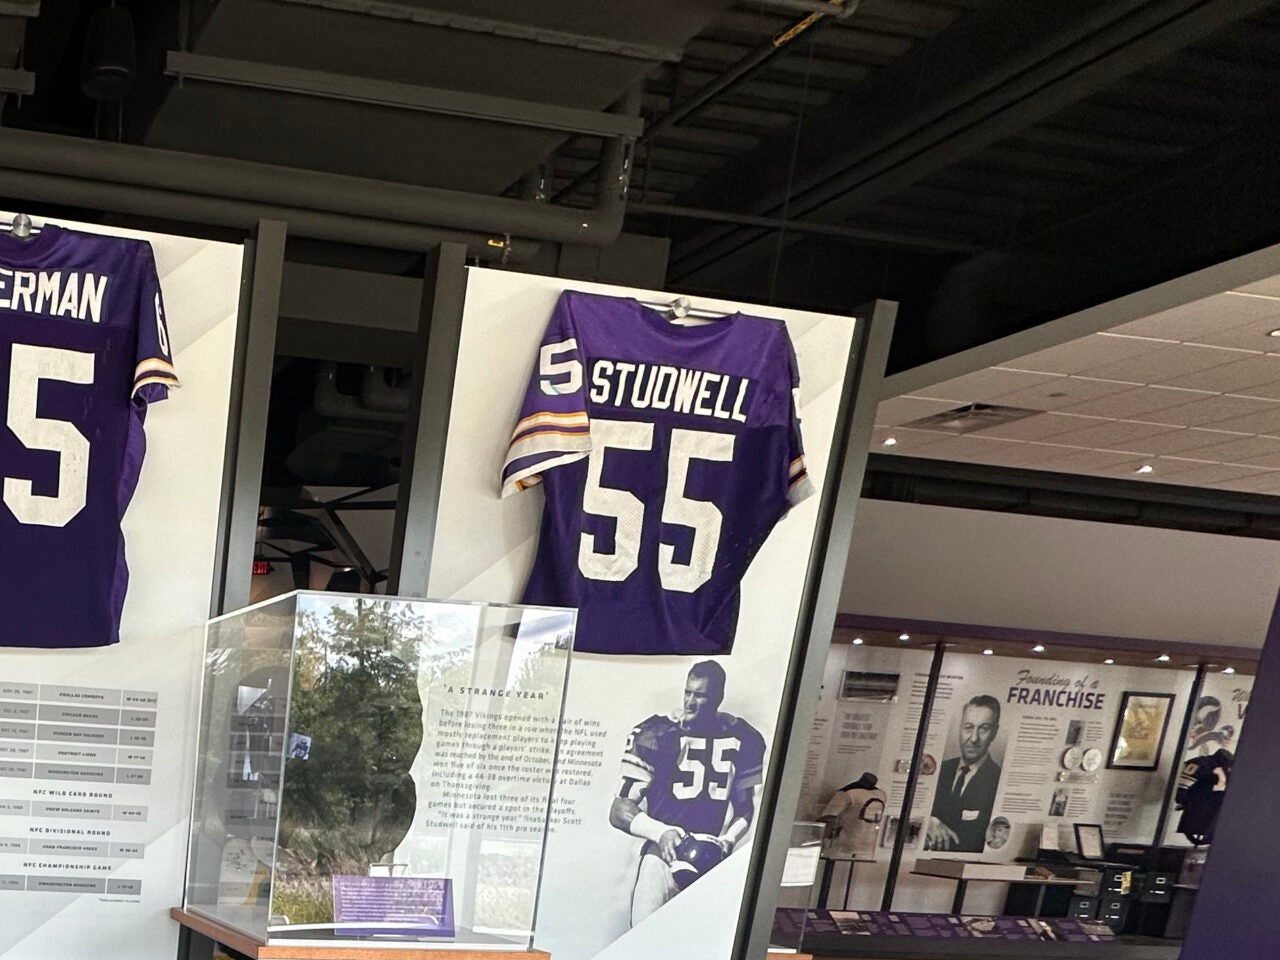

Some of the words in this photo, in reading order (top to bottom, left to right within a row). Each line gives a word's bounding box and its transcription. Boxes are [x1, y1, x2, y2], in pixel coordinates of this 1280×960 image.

[540, 338, 583, 395] 5
[590, 360, 749, 423] STUDWELL
[578, 418, 736, 593] 55
[1017, 669, 1070, 689] Founding
[1073, 676, 1089, 690] of
[1090, 680, 1100, 689] a
[460, 687, 511, 698] STRANGE
[1007, 687, 1106, 710] FRANCHISE
[440, 709, 454, 717] The
[584, 719, 600, 727] wins
[570, 739, 596, 748] playing
[566, 750, 604, 758] agreement
[567, 758, 602, 767] Minnesota
[673, 736, 741, 800] 55
[569, 778, 591, 786] Dallas
[563, 817, 582, 825] Scott
[38, 863, 91, 871] CHAMPIONSHIP
